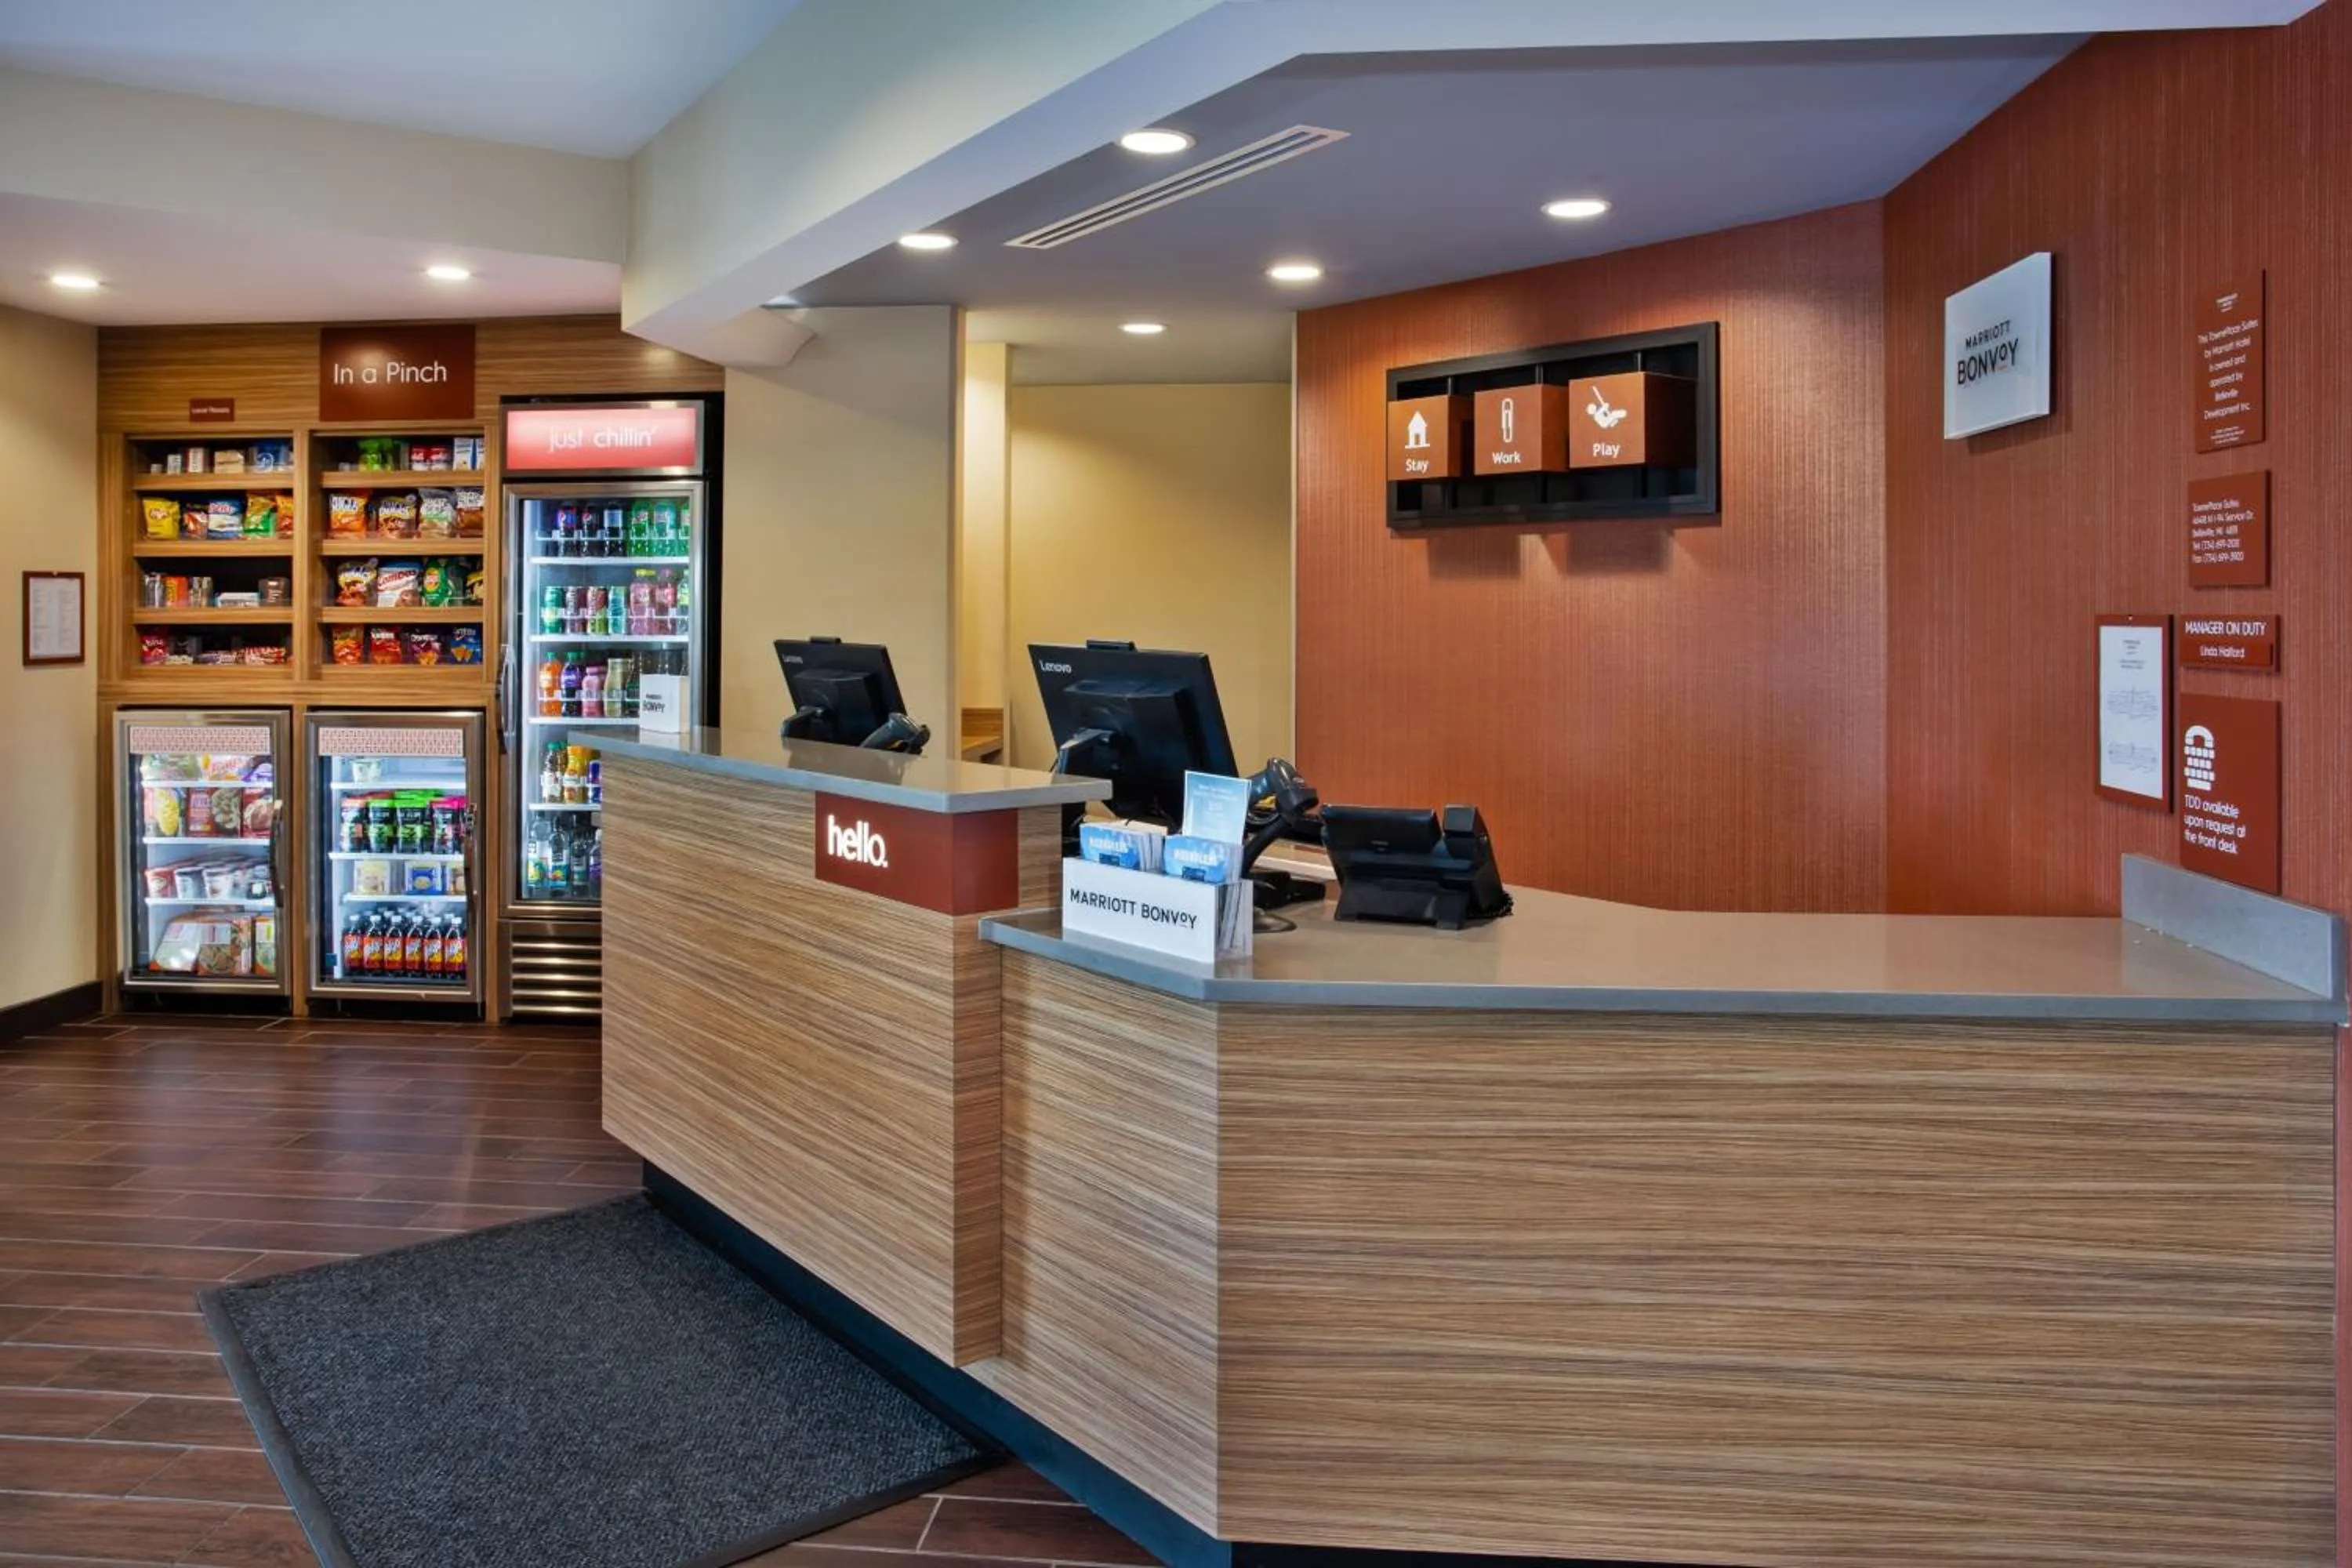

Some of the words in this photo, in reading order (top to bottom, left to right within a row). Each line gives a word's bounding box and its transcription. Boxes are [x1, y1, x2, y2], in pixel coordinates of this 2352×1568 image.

[1965, 319, 2011, 350] MARRIOTT
[333, 363, 354, 385] In
[361, 368, 377, 383] a
[386, 360, 448, 385] Pinch
[1957, 338, 2020, 385] BONVOY
[547, 426, 583, 455] just
[1592, 442, 1621, 459] Play
[1404, 459, 1429, 473] Stay
[1492, 451, 1522, 465] Work
[2184, 620, 2224, 635] MANAGER
[2226, 620, 2241, 636] ON
[2242, 621, 2267, 637] DUTY
[1039, 659, 1073, 674] Lenovo
[2184, 793, 2201, 810] TDD
[2202, 800, 2241, 819] available
[2184, 814, 2205, 829] upon
[2205, 819, 2235, 836] request
[2237, 824, 2246, 838] at
[827, 814, 888, 869] hello.
[1069, 887, 1137, 916] MARRIOTT
[1141, 902, 1198, 930] BONVOY
